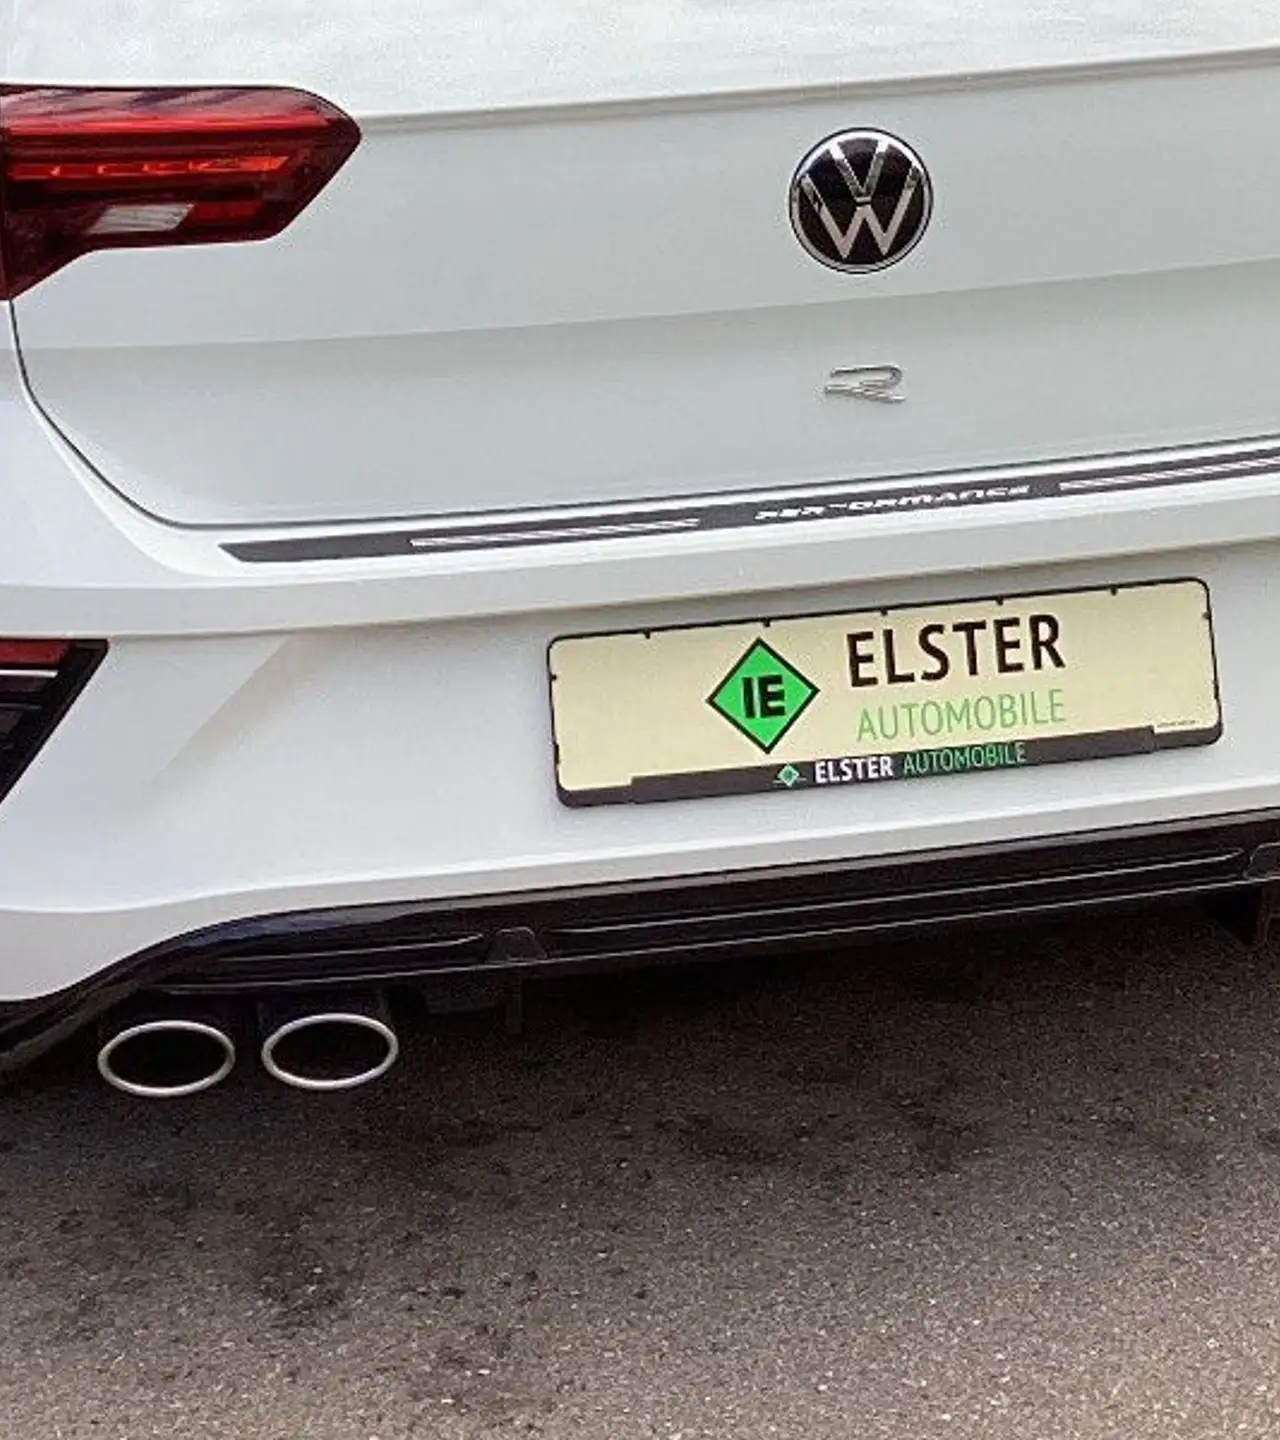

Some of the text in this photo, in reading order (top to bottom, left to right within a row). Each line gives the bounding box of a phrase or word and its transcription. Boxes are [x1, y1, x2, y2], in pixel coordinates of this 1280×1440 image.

[846, 614, 1066, 687] ELSTER
[741, 674, 786, 719] IE
[856, 689, 1066, 741] AUTOMOBILE
[815, 756, 894, 784] ELSTER
[902, 742, 1026, 775] AUTOMOBILE
